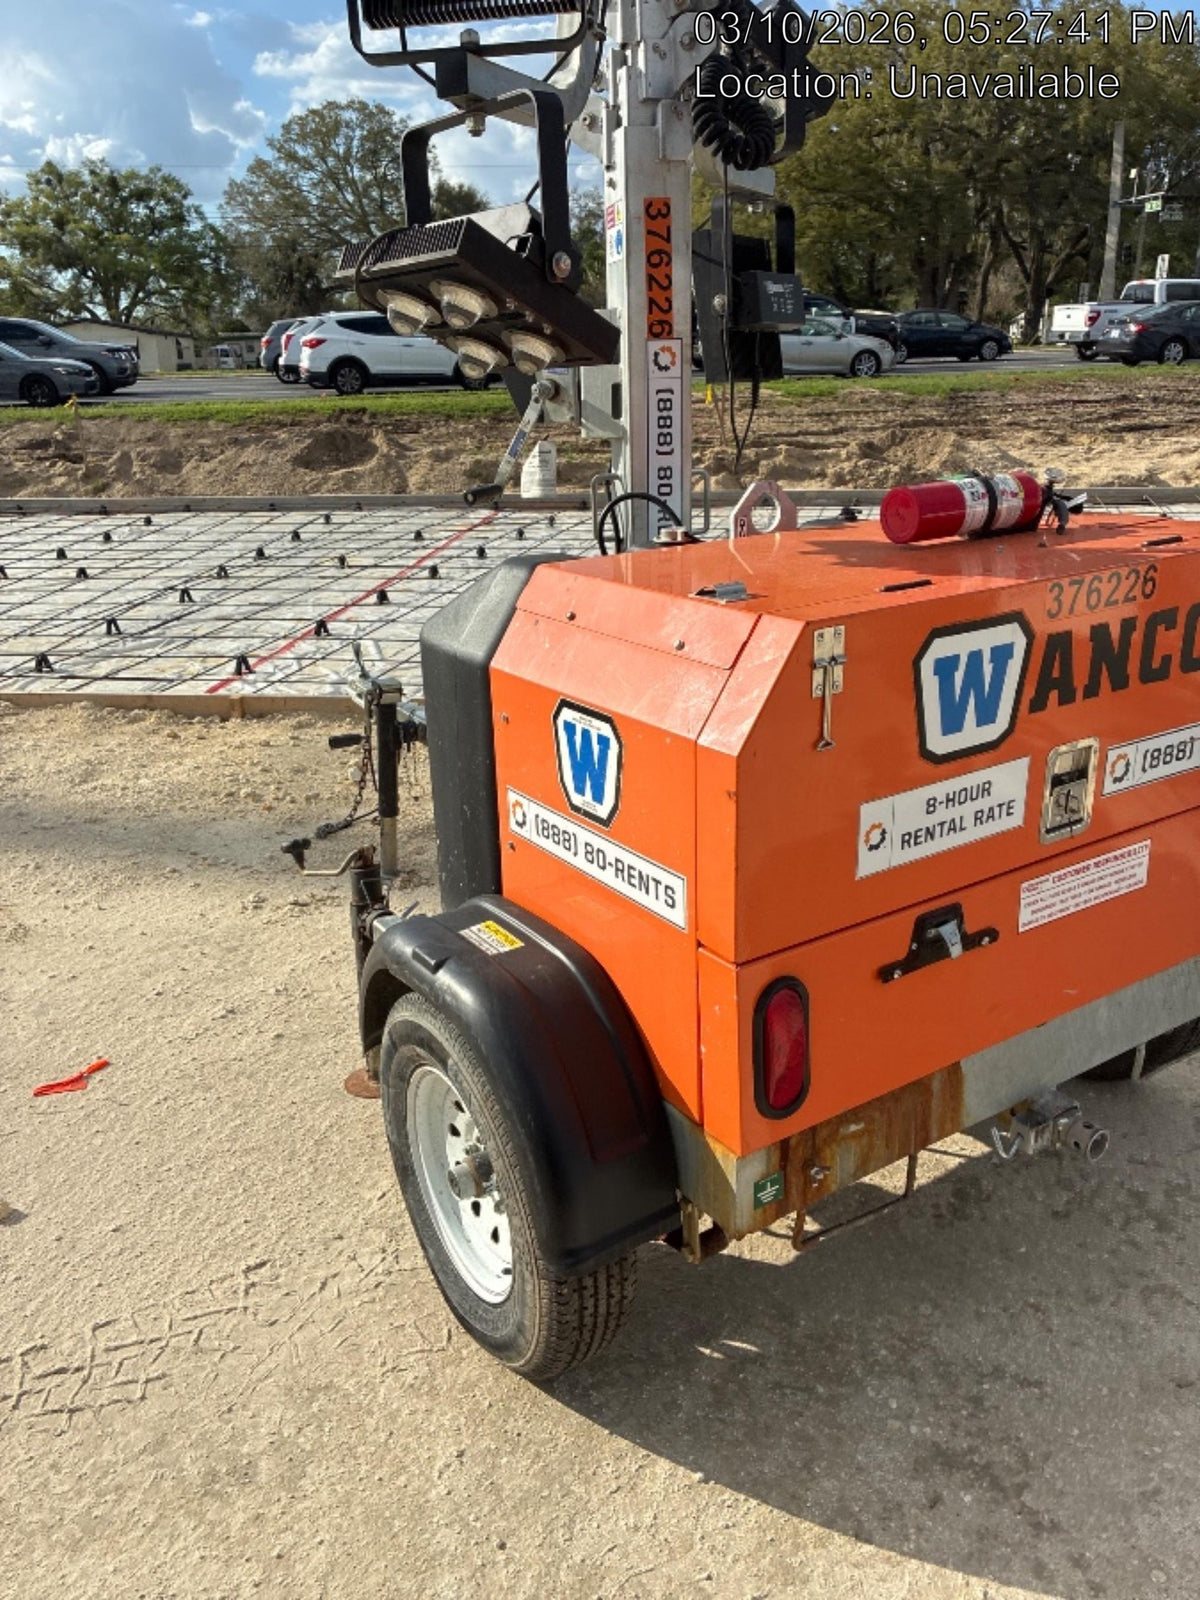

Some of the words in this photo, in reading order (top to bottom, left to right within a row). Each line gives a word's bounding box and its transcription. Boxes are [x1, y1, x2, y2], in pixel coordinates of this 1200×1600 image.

[645, 200, 673, 339] 376226
[655, 388, 675, 456] (888)
[1046, 565, 1158, 619] 376226
[563, 719, 610, 806] W
[1141, 736, 1194, 773] (888)
[901, 816, 967, 850] RENTAL
[974, 799, 1016, 827] RATE
[925, 780, 993, 815] 8-HOUR
[534, 813, 578, 857] (888)
[584, 841, 676, 909] 80-RENTS
